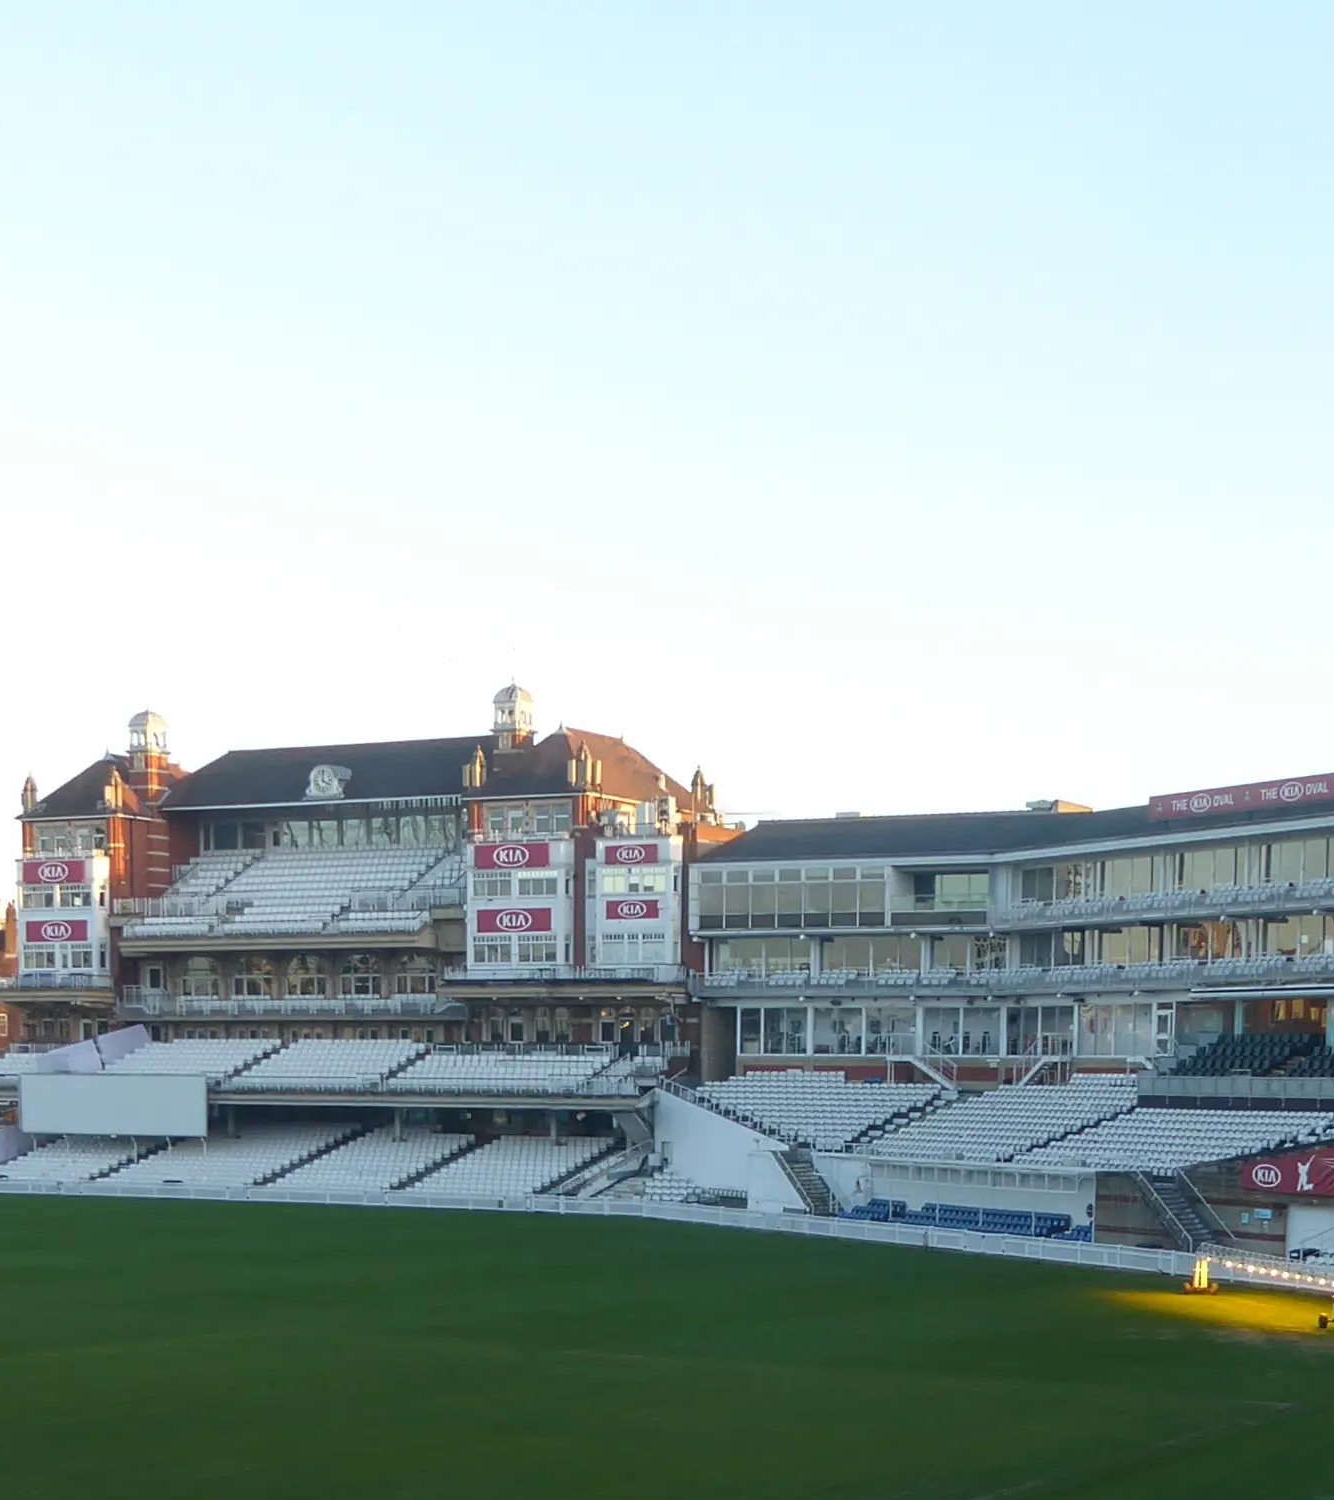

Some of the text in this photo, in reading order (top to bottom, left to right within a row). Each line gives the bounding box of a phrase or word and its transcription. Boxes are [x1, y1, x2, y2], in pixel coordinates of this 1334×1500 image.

[1260, 788, 1279, 801] THE
[1305, 782, 1329, 796] OVAL
[1171, 799, 1188, 812] THE
[1213, 795, 1234, 807] OVAL
